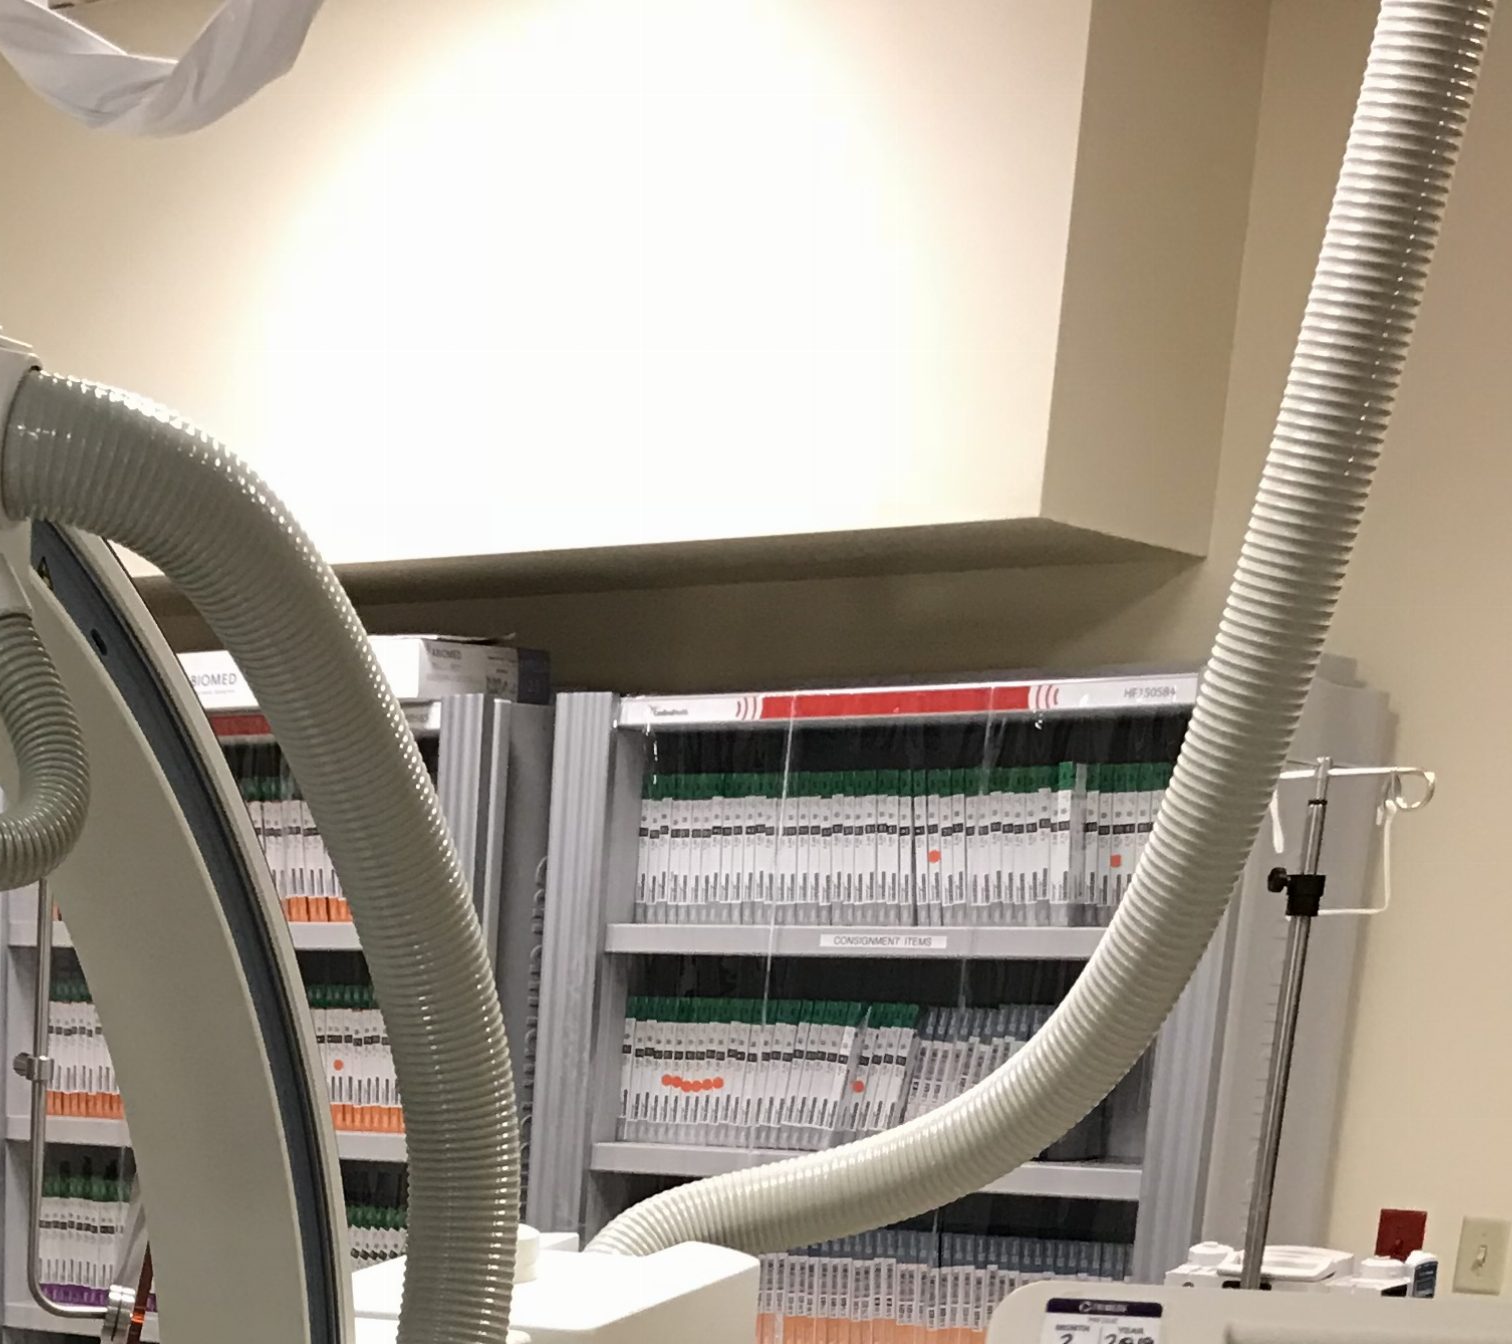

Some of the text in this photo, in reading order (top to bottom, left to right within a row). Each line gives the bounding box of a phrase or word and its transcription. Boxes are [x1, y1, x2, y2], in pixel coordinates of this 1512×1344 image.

[189, 673, 237, 688] BIOMED
[833, 936, 932, 947] CONSIGNMENT ITEMS
